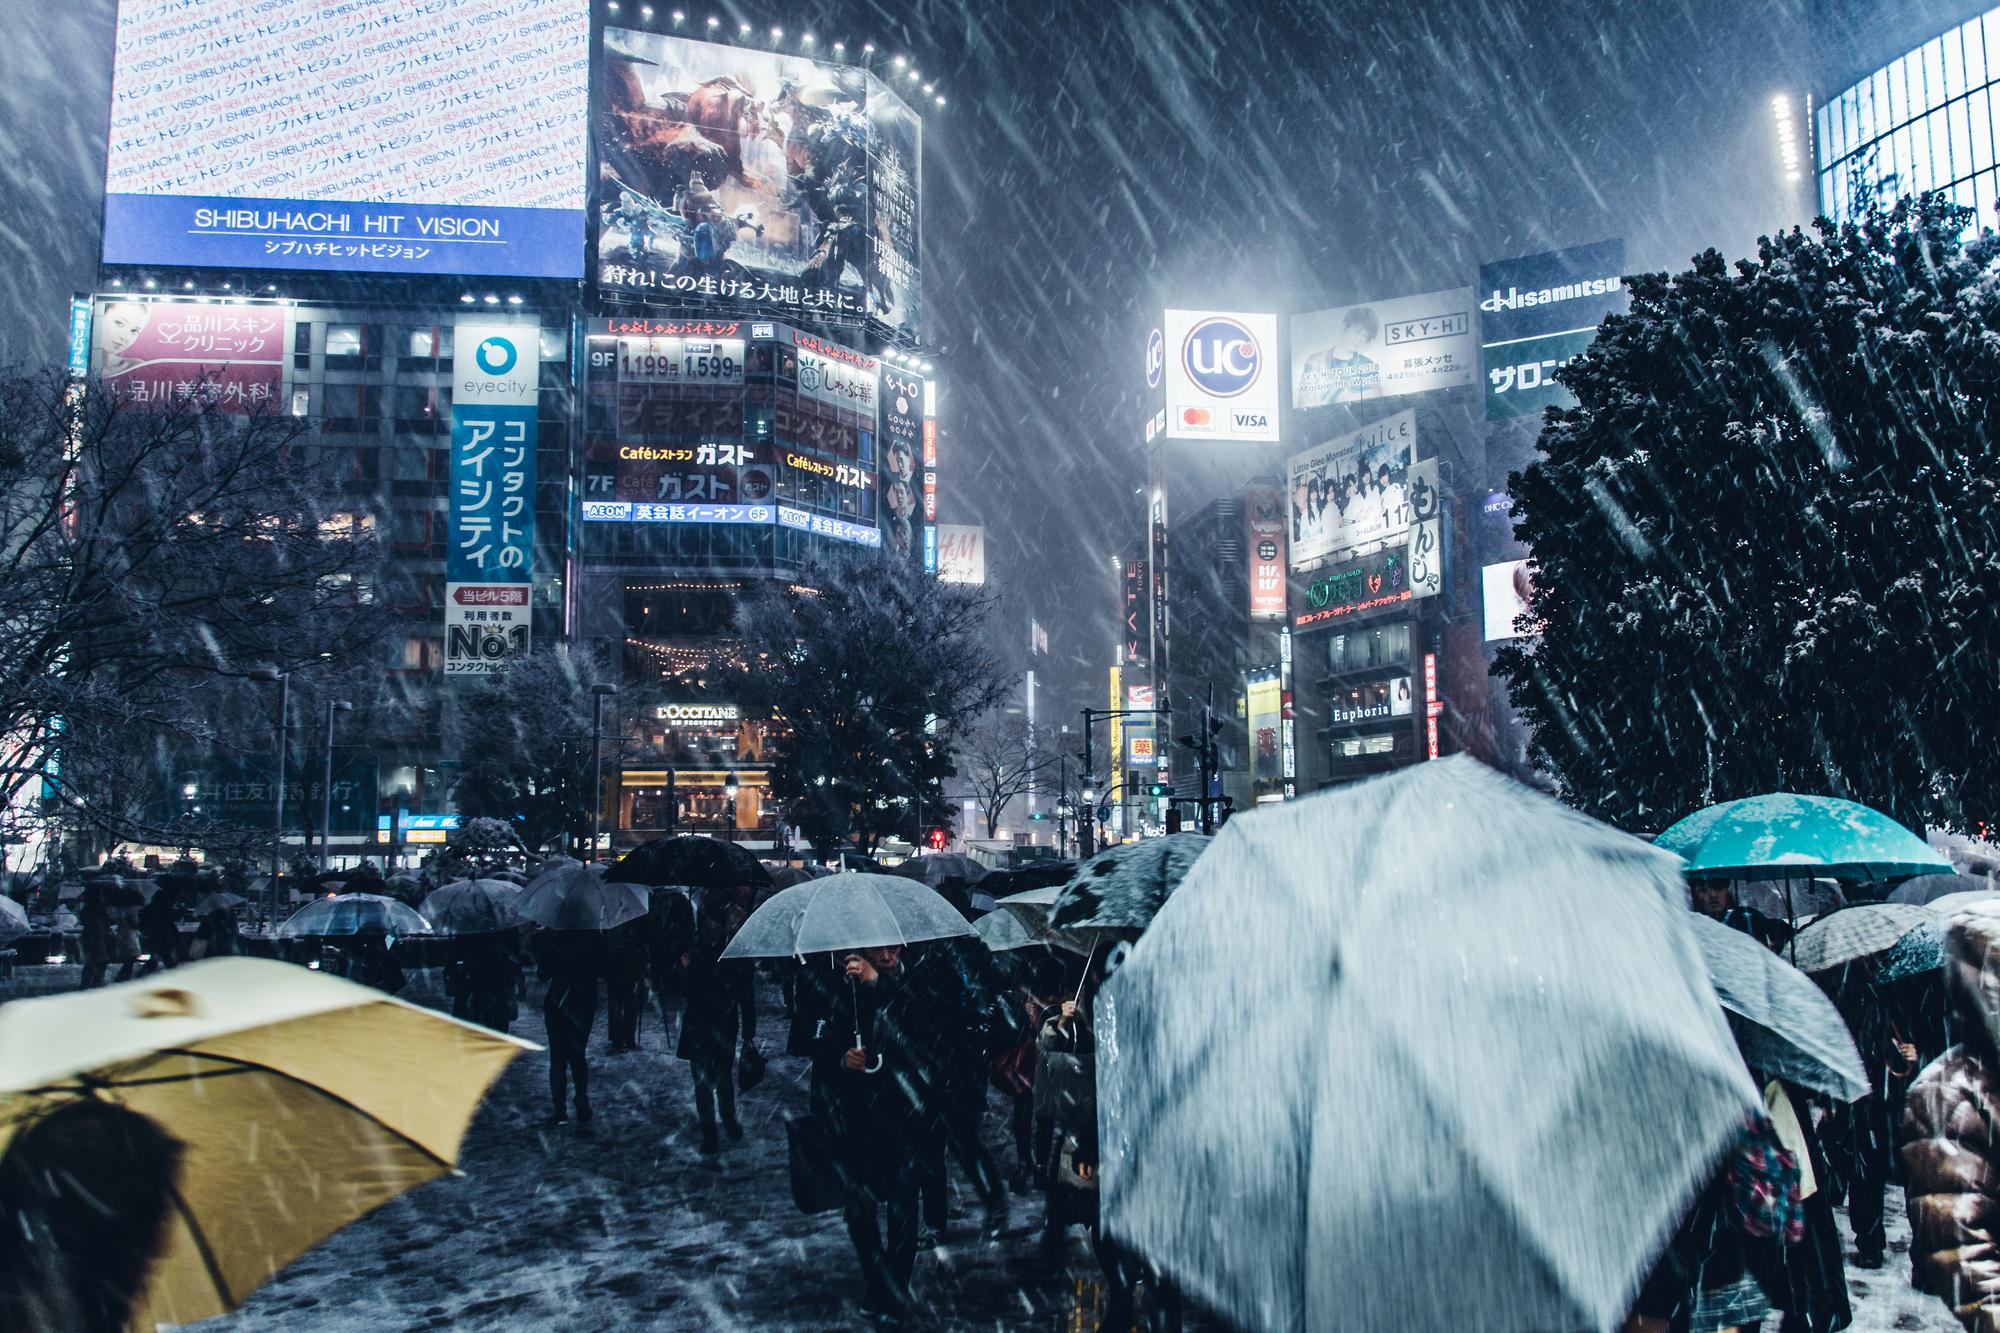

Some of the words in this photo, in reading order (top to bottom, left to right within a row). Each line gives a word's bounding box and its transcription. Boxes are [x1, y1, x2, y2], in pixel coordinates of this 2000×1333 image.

[144, 14, 220, 45] SHIBUHACHI
[227, 7, 246, 21] HIT
[131, 54, 173, 74] VISION
[185, 14, 311, 58] シブハチヒットビジョン
[145, 106, 164, 120] HIT
[170, 92, 213, 113] VISION
[224, 52, 351, 97] シブハチヒットビジョン
[362, 27, 437, 57] SHIBUHACHI
[442, 20, 461, 34] HIT
[465, 6, 508, 27] VISION
[186, 53, 260, 83] SHIBUHACHI
[267, 46, 286, 59] HIT
[291, 32, 333, 52] VISION
[224, 92, 300, 122] SHIBUHACHI
[307, 84, 326, 98] HIT
[331, 70, 373, 91] VISION
[383, 31, 508, 76] シブハチヒットビジョン
[186, 145, 204, 158] HIT
[211, 130, 255, 151] VISION
[265, 91, 392, 136] シブハチヒットビジョン
[403, 66, 477, 96] SHIBUHACHI
[482, 59, 501, 73] HIT
[506, 46, 547, 66] VISION
[266, 130, 342, 160] SHIBUHACHI
[348, 123, 367, 136] HIT
[372, 109, 414, 129] VISION
[423, 70, 548, 115] シブハチヒットビジョン
[252, 168, 296, 189] VISION
[305, 129, 431, 174] シブハチヒットビジョン
[443, 104, 517, 134] SHIBUHACHI
[522, 98, 540, 111] HIT
[483, 143, 558, 173] SHIBUHACHI
[563, 136, 581, 149] HIT
[307, 169, 382, 199] SHIBUHACHI
[388, 162, 406, 175] HIT
[412, 147, 455, 168] VISION
[872, 169, 915, 214] MONSTER
[876, 190, 912, 228] HUNTER
[195, 209, 350, 232] SHIBUHACHI
[365, 214, 404, 234] HIT
[416, 216, 499, 237] VISION
[265, 240, 430, 259] シブハチヒットビジョン
[1480, 277, 1621, 312] Hisamitsu
[184, 315, 277, 333] 品川スキン
[608, 319, 739, 336] しゃぶしゃぶバイキング
[1392, 318, 1462, 341] SKY-HI
[184, 336, 265, 353] クリニック
[591, 352, 614, 367] 9F
[1360, 363, 1380, 373] 2018
[464, 380, 527, 396] eyecity
[824, 370, 873, 403] しゃぶ葉
[885, 374, 918, 398] EXO
[1234, 415, 1267, 426] VISA
[697, 443, 754, 466] ガスト
[1294, 463, 1310, 475] Little
[1310, 456, 1326, 468] Glee
[1326, 446, 1354, 462] Monster
[588, 475, 615, 492] 7F
[658, 472, 730, 499] ガスト
[835, 465, 871, 489] ガスト
[459, 420, 496, 568] アイシティ
[499, 421, 526, 568] コンタクトの
[590, 505, 625, 518] AEON
[636, 505, 743, 520] 英会話イーオン
[751, 509, 766, 519] 6F
[783, 511, 807, 528] AEON
[1484, 503, 1501, 513] DHC
[812, 516, 879, 542] 英会話イーオン
[1410, 476, 1440, 591] もんじゃ
[939, 533, 976, 560] H&M
[463, 590, 523, 603] 当ビル5階
[464, 610, 513, 621] 利用者数
[1128, 562, 1137, 660] KATE
[658, 705, 738, 719] L'OCCITANE
[1334, 704, 1389, 722] Euphoria
